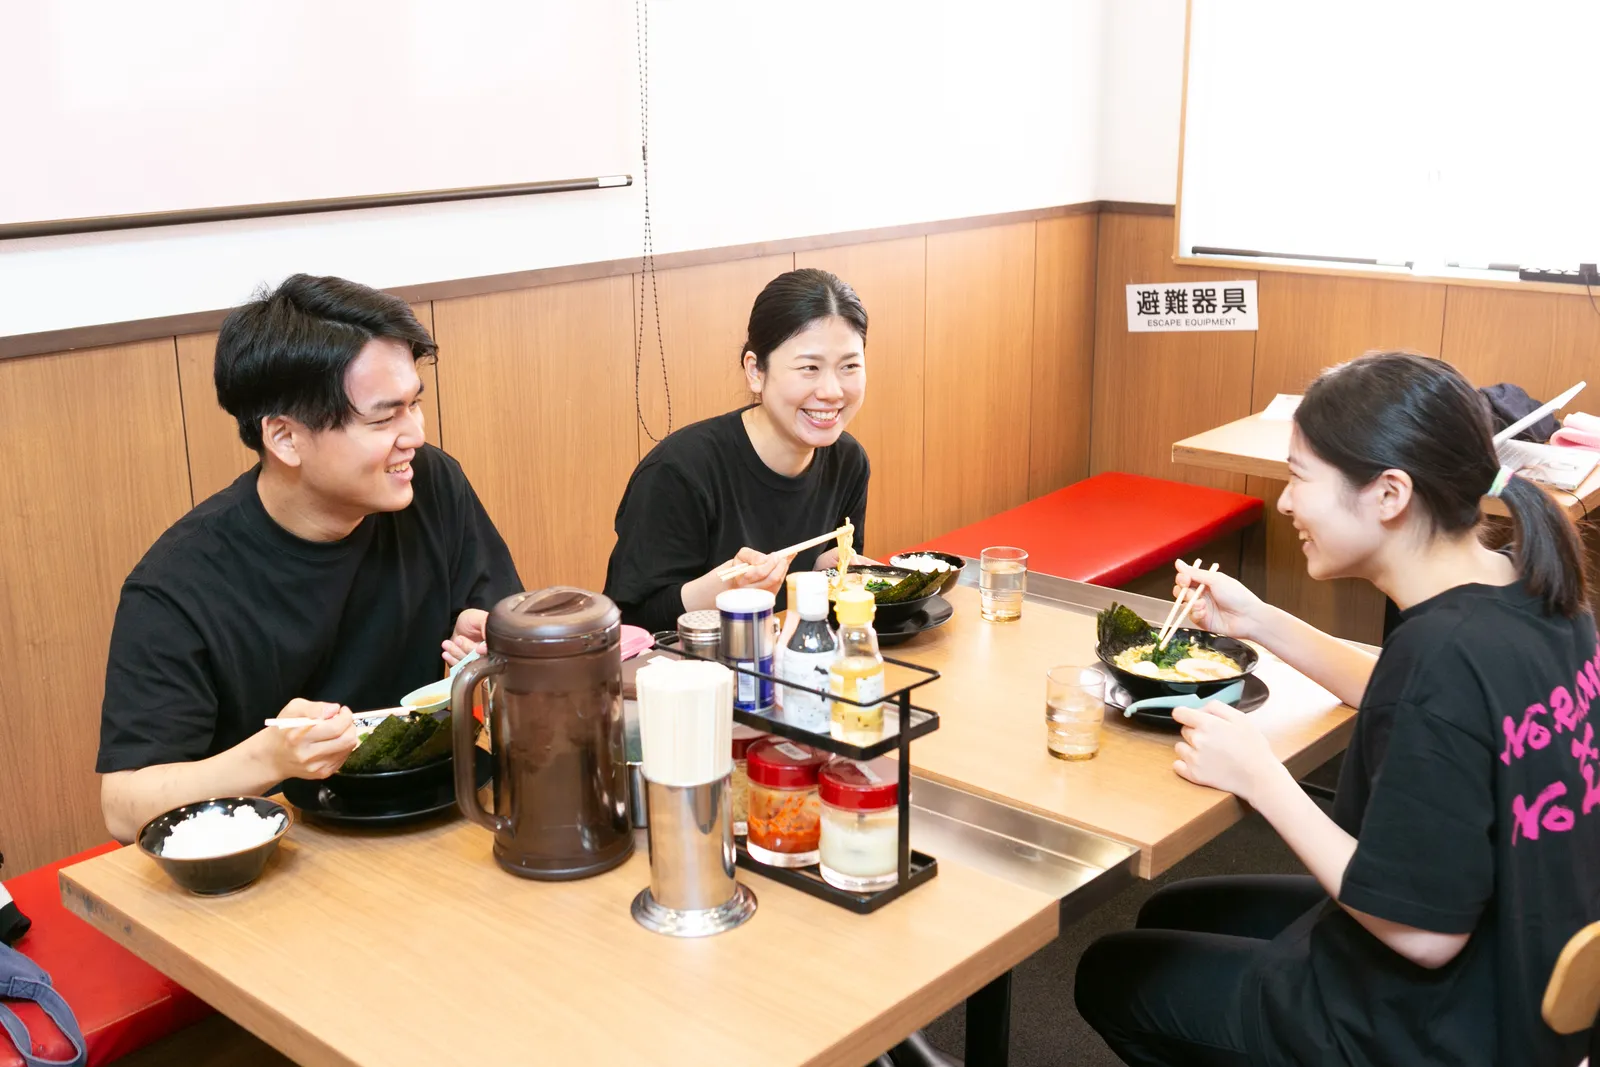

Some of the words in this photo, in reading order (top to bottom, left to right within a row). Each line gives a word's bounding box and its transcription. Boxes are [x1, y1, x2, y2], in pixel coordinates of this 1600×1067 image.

[1136, 287, 1247, 316] 避難器具
[1147, 318, 1182, 327] ESCAPE
[1185, 317, 1236, 326] EQUIPMENT
